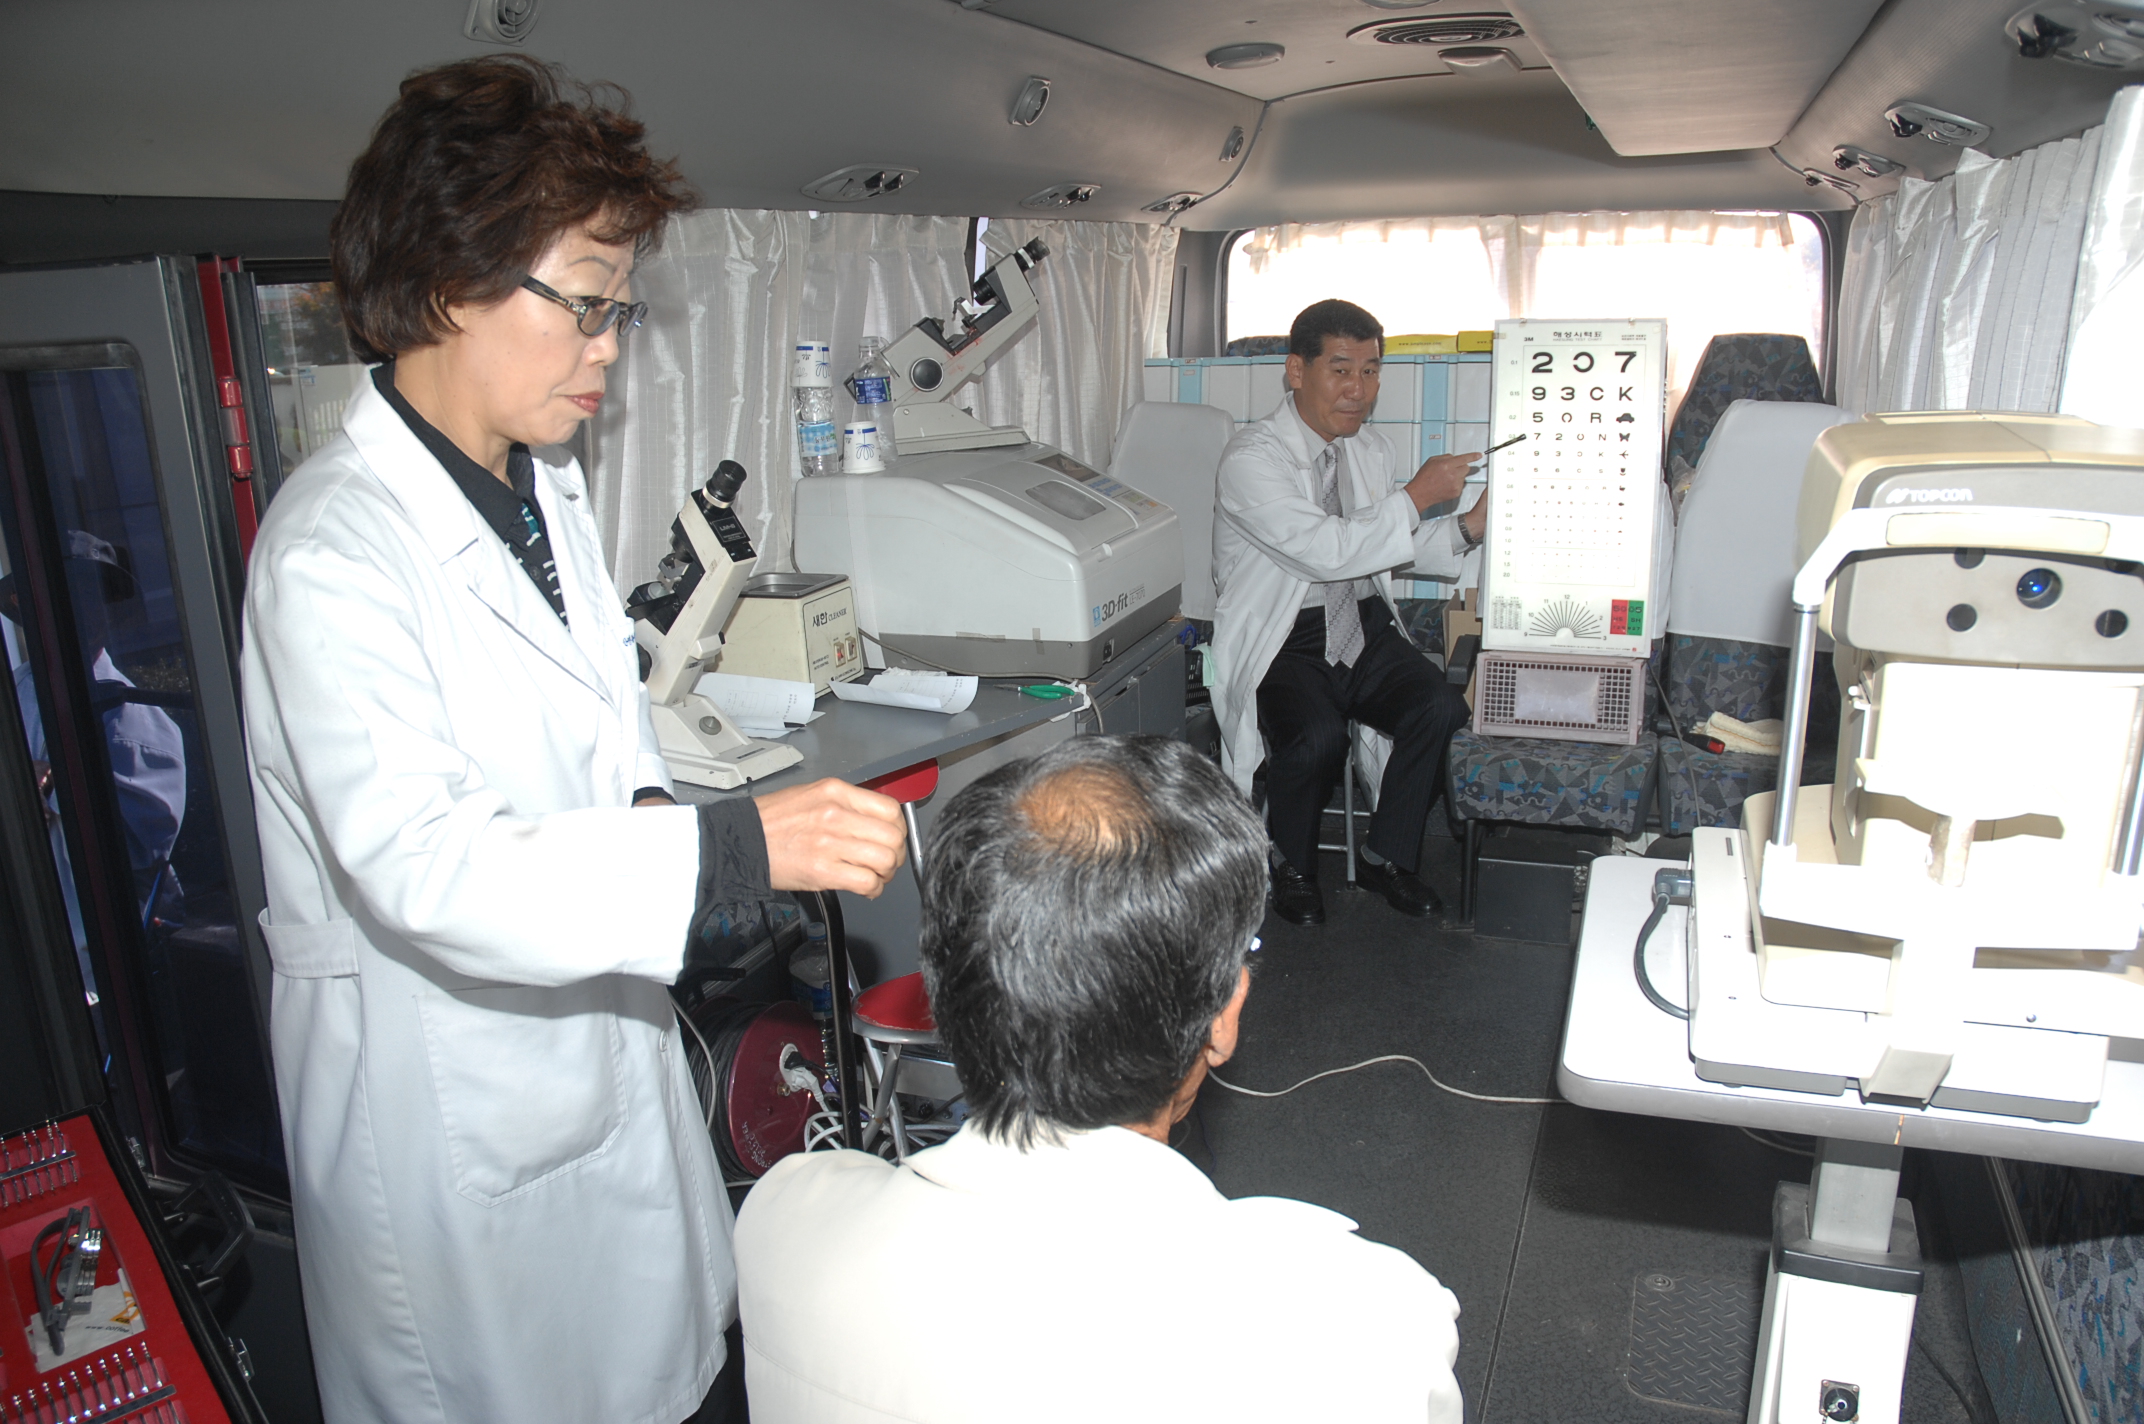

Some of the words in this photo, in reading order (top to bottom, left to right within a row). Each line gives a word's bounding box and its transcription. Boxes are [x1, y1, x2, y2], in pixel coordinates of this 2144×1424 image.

[1531, 351, 1554, 373] 2
[1614, 351, 1637, 373] 7
[1531, 386, 1546, 401] 9
[1560, 386, 1576, 401] 3
[1589, 386, 1604, 401] C
[1618, 386, 1634, 401] K
[1532, 412, 1544, 423] 5
[1590, 412, 1602, 423] R
[1534, 432, 1541, 440] 7
[1555, 433, 1563, 441] 2
[1598, 433, 1607, 441] N
[1908, 488, 1973, 503] TOPCON
[828, 608, 847, 621] CLEANER
